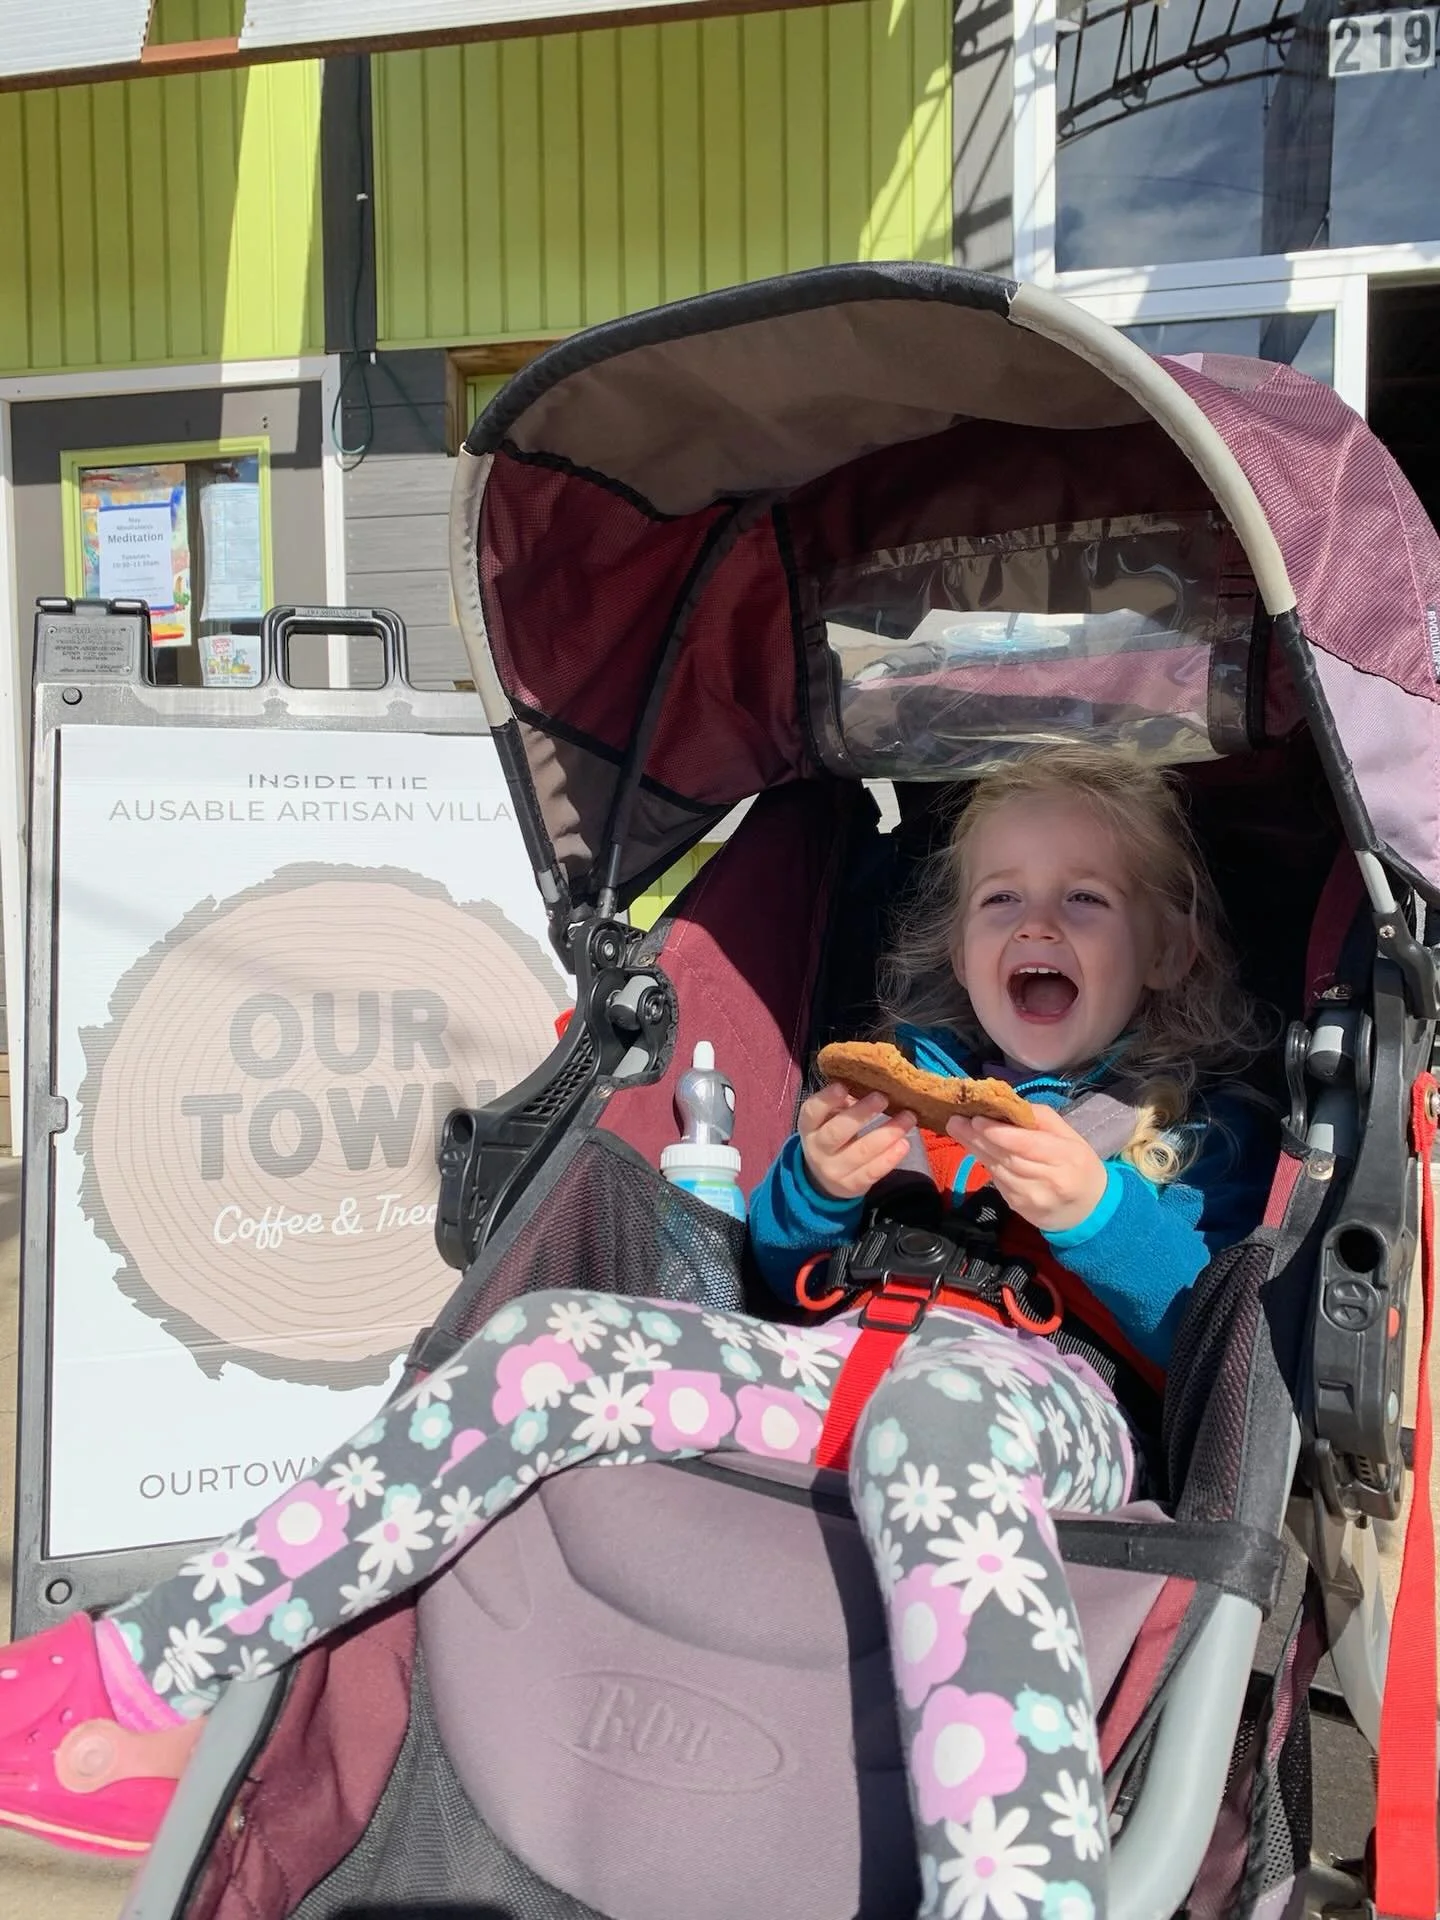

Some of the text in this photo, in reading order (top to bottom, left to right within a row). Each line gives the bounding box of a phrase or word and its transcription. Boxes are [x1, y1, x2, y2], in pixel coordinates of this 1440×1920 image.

[1334, 12, 1431, 73] 219
[107, 532, 164, 544] Meditation
[247, 773, 429, 790] INSIDE THE
[108, 800, 266, 822] AUSABLE
[276, 801, 415, 822] ARTISAN
[229, 989, 450, 1080] OUR
[213, 1205, 325, 1249] Coffee
[331, 1197, 364, 1236] &
[139, 1456, 320, 1499] OURTOW
